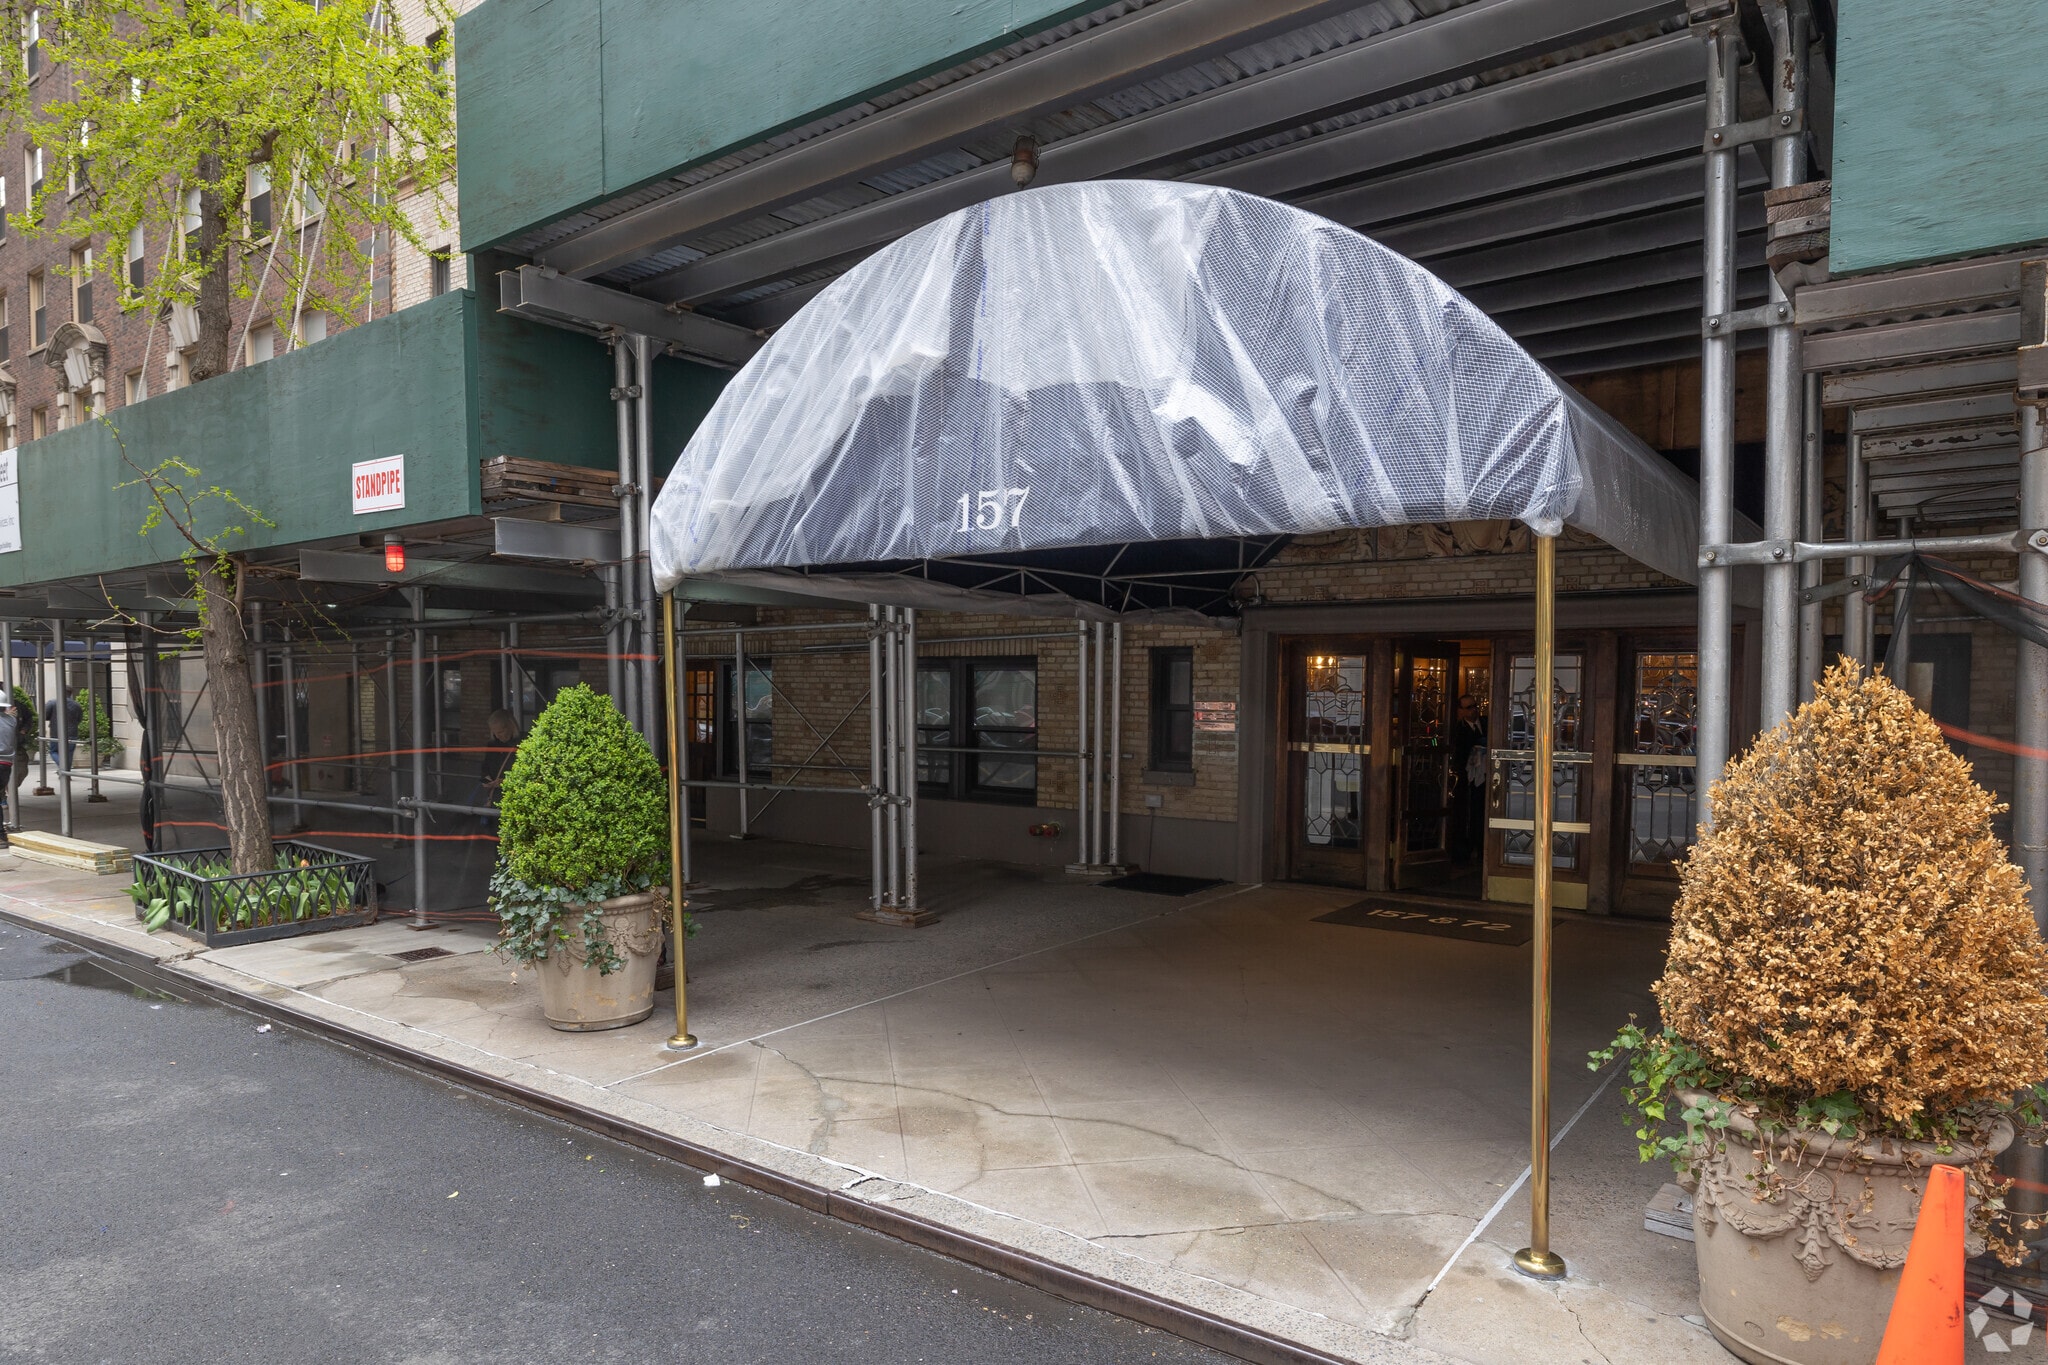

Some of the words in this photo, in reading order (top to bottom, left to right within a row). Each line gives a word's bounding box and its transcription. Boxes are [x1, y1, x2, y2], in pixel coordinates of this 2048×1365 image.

[356, 469, 401, 499] STANDPIPE
[957, 486, 1030, 532] 157
[1366, 909, 1429, 920] 157
[1461, 919, 1512, 932] 72
